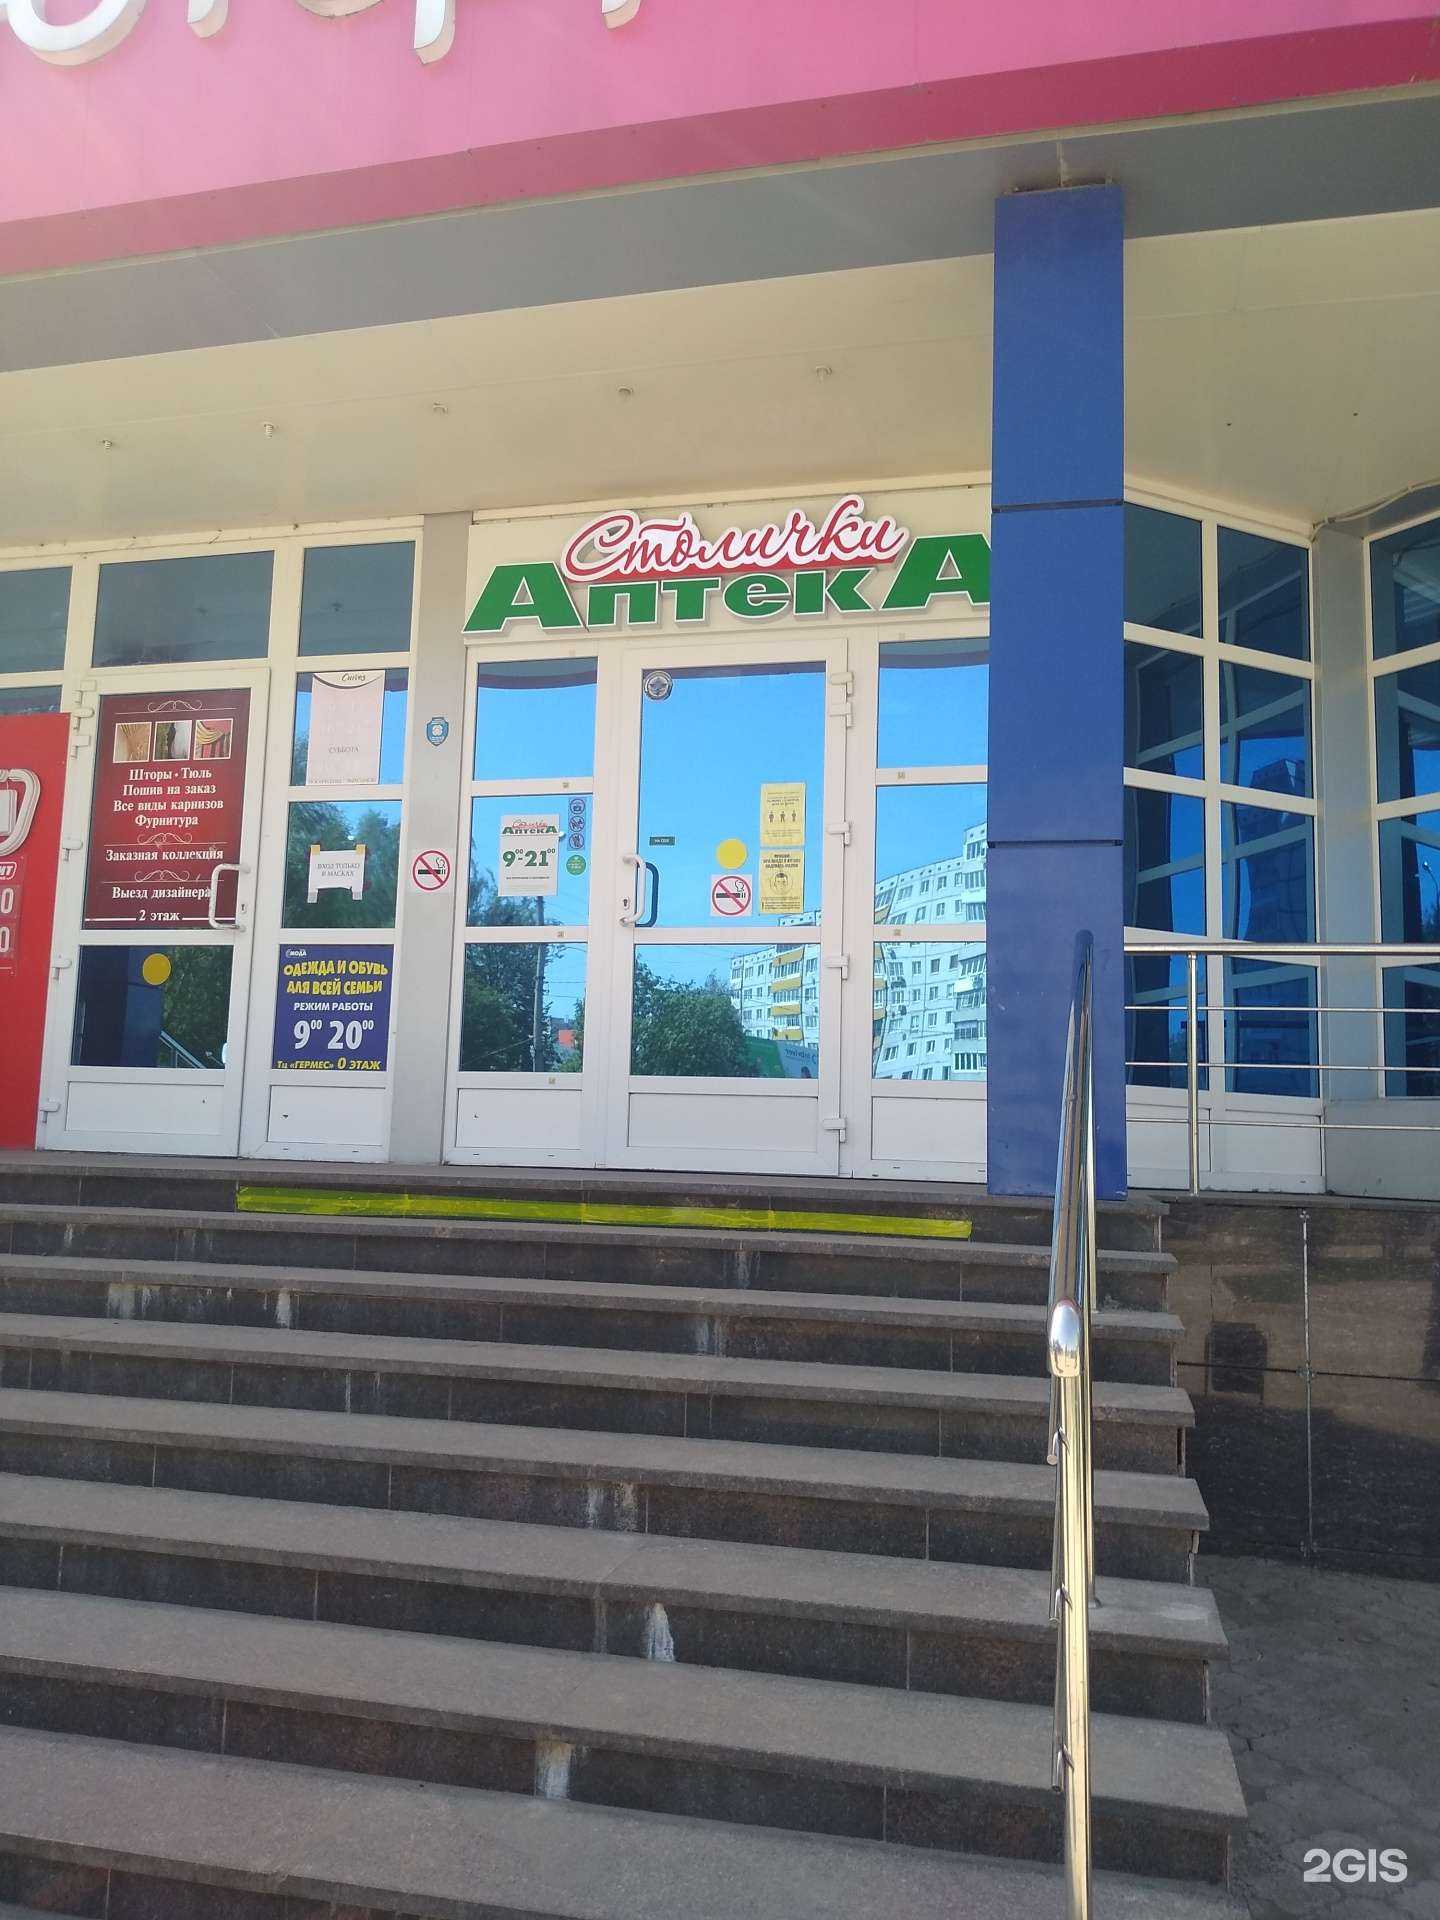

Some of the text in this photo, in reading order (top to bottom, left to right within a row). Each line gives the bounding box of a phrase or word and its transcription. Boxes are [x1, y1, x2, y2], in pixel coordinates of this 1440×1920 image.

[564, 496, 908, 578] Столички
[128, 767, 212, 782] Шторы Тюль
[123, 783, 217, 796] Пошив на заказ
[113, 800, 224, 812] Все виды карнизов
[135, 815, 199, 829] Фурнитура
[106, 849, 224, 861] Заказная коллекция
[112, 886, 211, 901] Выезд дизайнера
[139, 910, 180, 921] 2 этаж
[284, 960, 388, 976] ОДЕЖДА И ОБУВЬ
[287, 978, 382, 995] ДЛЯ ВСЕЙ СЕМЬИ
[294, 1002, 373, 1011] РЕЖИМ РАБОТЫ
[338, 1057, 346, 1069] 0
[349, 1060, 381, 1070] ЭТАЖ
